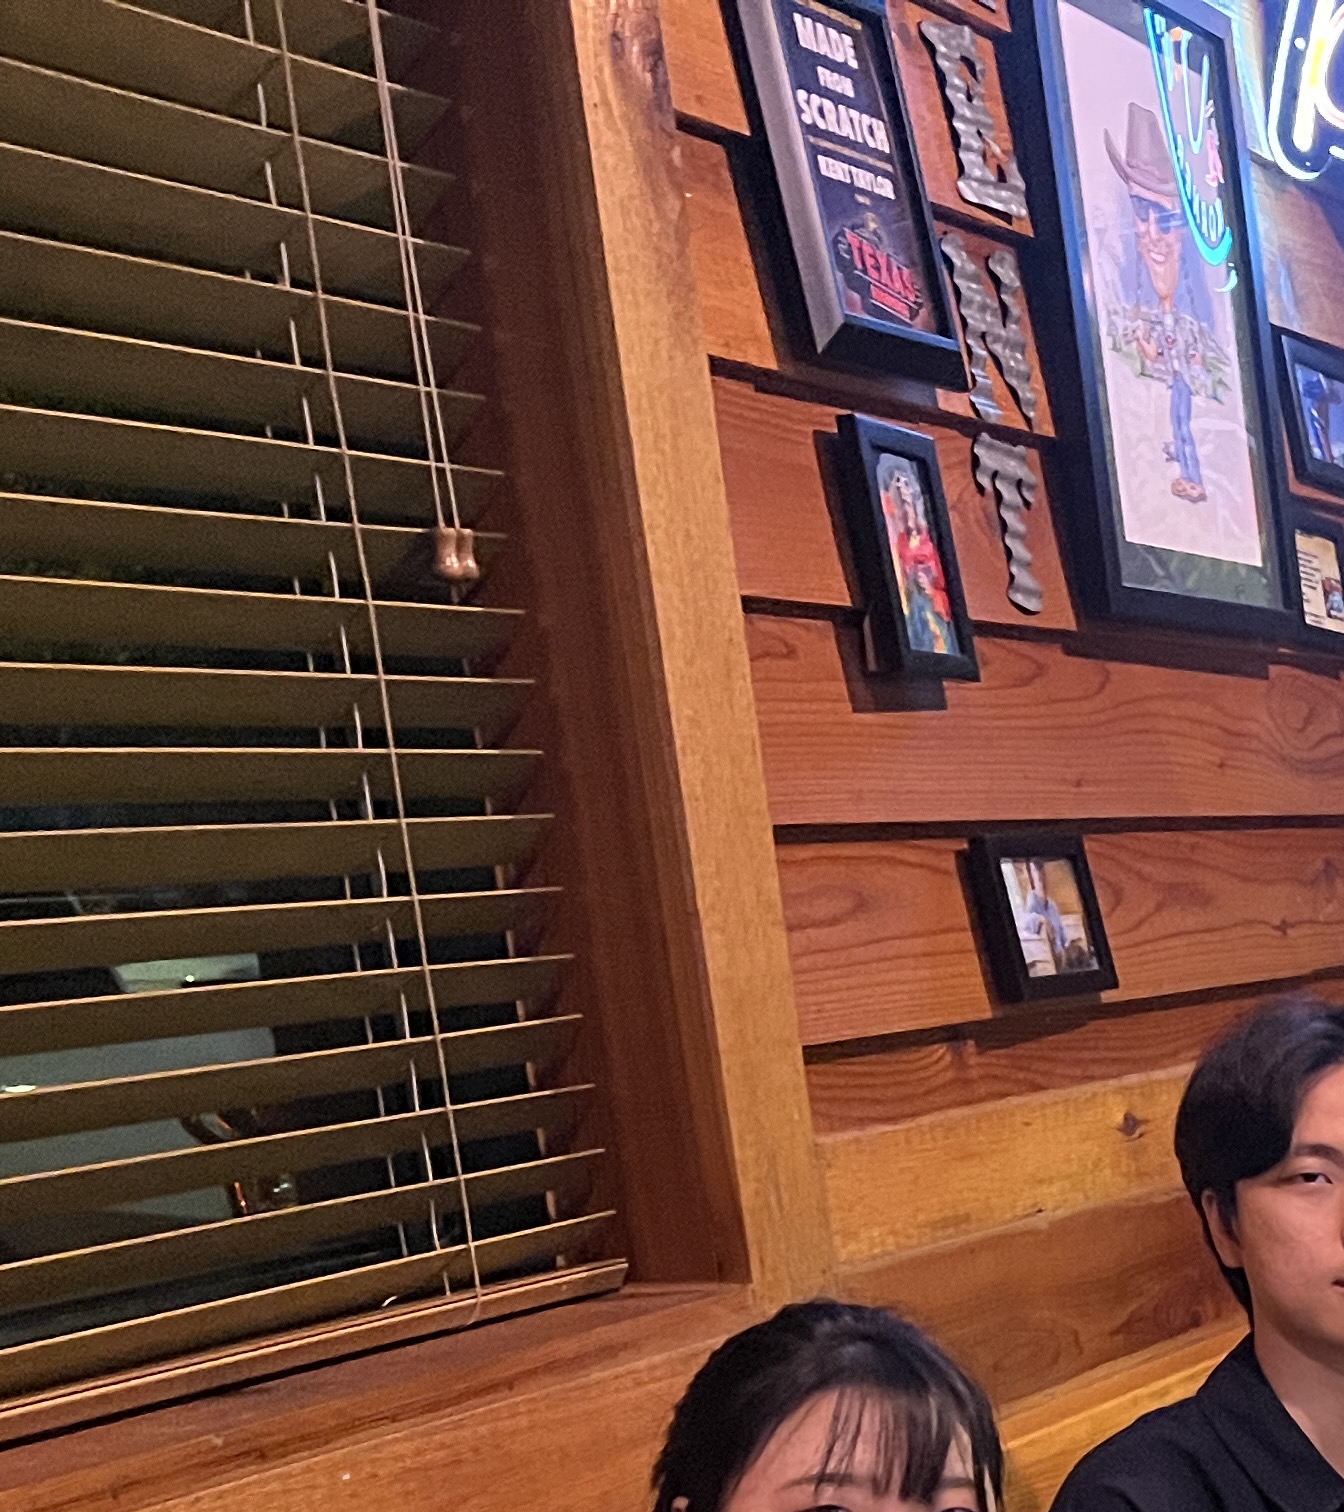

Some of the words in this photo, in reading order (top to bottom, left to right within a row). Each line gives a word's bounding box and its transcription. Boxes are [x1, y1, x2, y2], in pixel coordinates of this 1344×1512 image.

[793, 12, 859, 69] MADE
[795, 89, 890, 154] SCRATCH
[844, 228, 918, 301] TEXAS
[918, 0, 1043, 614] ENT
